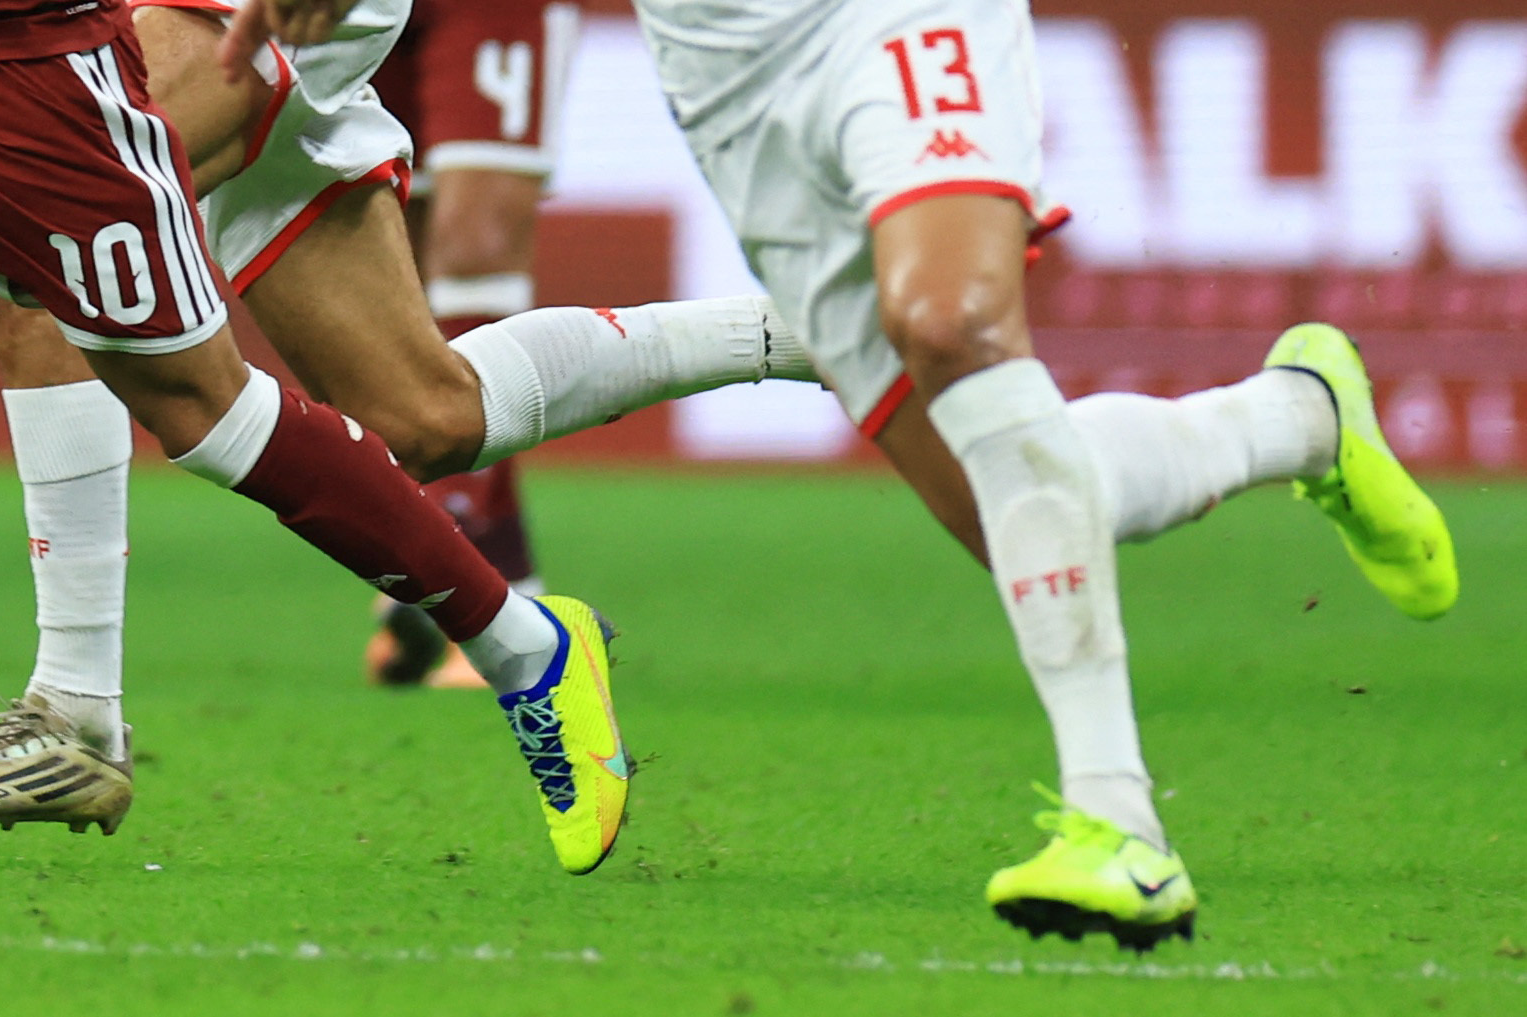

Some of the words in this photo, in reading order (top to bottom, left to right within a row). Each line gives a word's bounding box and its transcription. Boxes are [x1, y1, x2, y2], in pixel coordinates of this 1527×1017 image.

[473, 39, 533, 140] 4
[883, 28, 984, 120] 13
[49, 221, 157, 325] 10
[28, 537, 50, 559] TF
[1012, 566, 1087, 605] FTF
